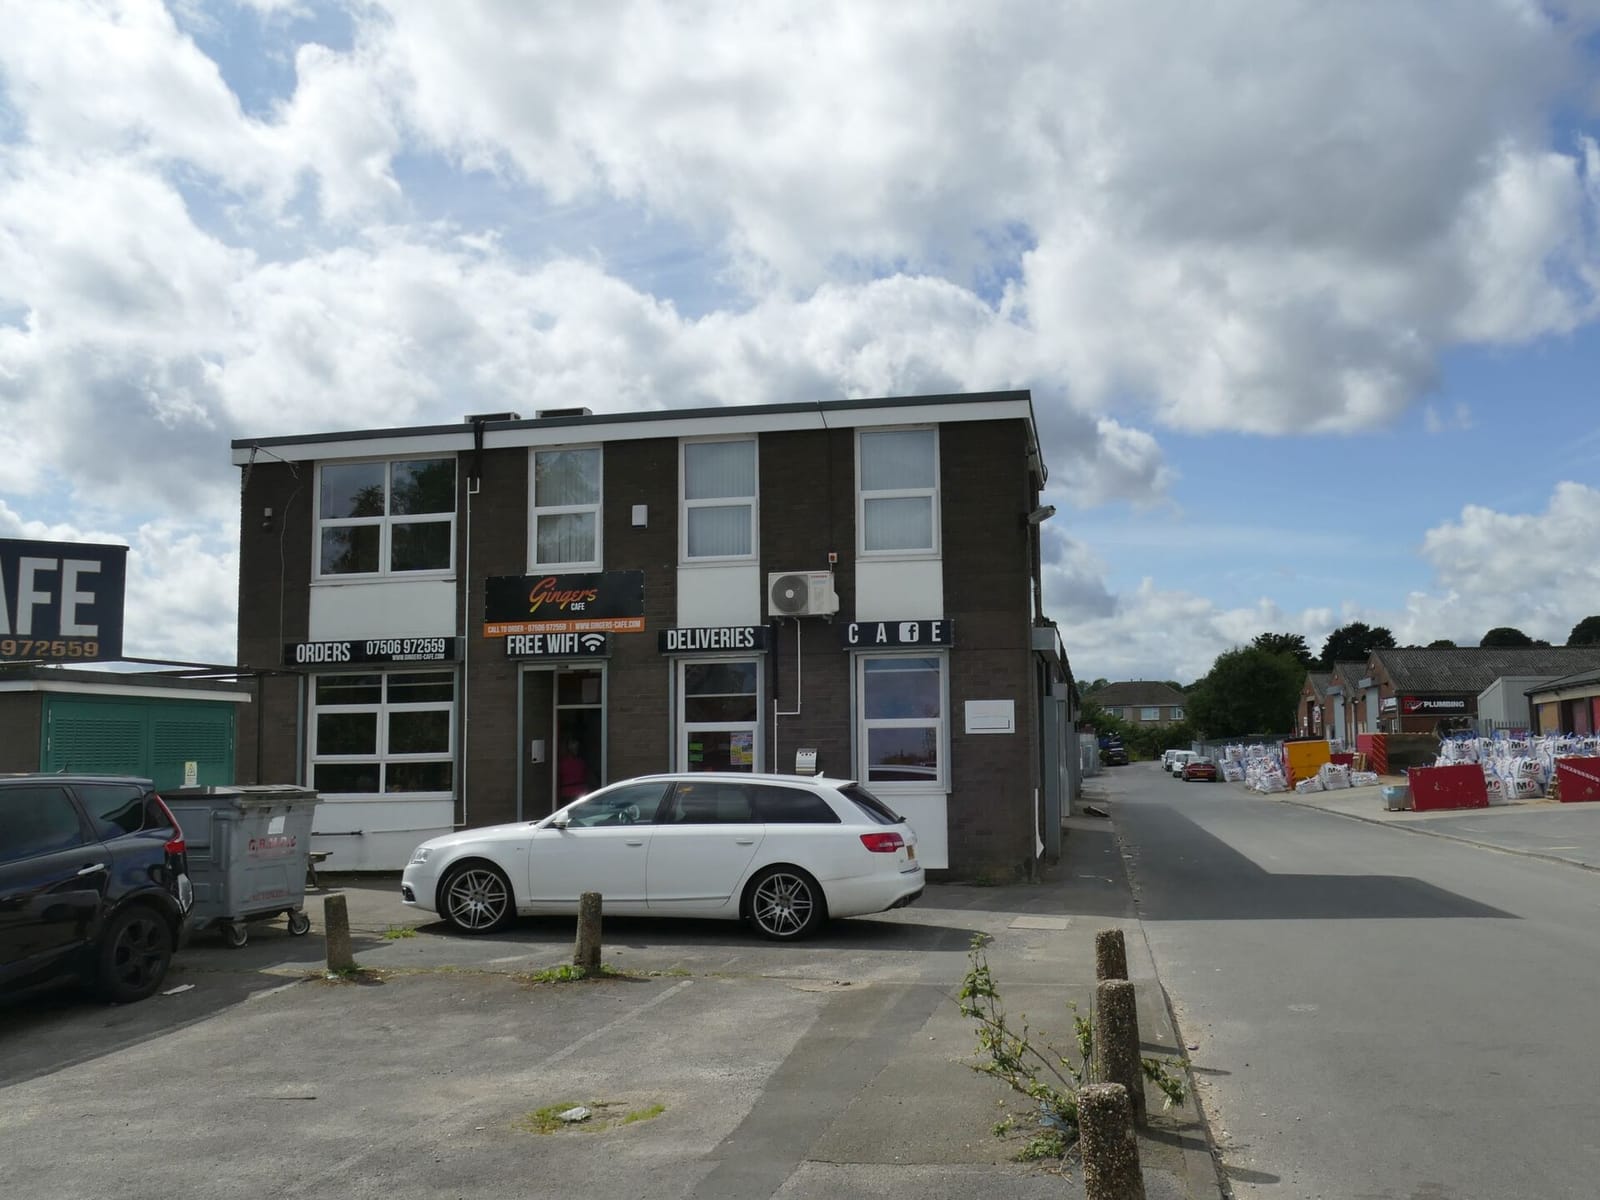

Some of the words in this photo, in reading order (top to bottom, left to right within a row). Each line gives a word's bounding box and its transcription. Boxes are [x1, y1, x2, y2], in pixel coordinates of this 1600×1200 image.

[529, 577, 598, 613] Gingers
[570, 602, 586, 611] CAFE
[1, 640, 99, 657] 972559
[507, 634, 543, 655] FREE
[547, 633, 579, 653] WIFI
[667, 627, 754, 650] DELIVERIES
[296, 642, 351, 664] ORDERS
[366, 640, 400, 655] 07506
[403, 638, 445, 654] 972559
